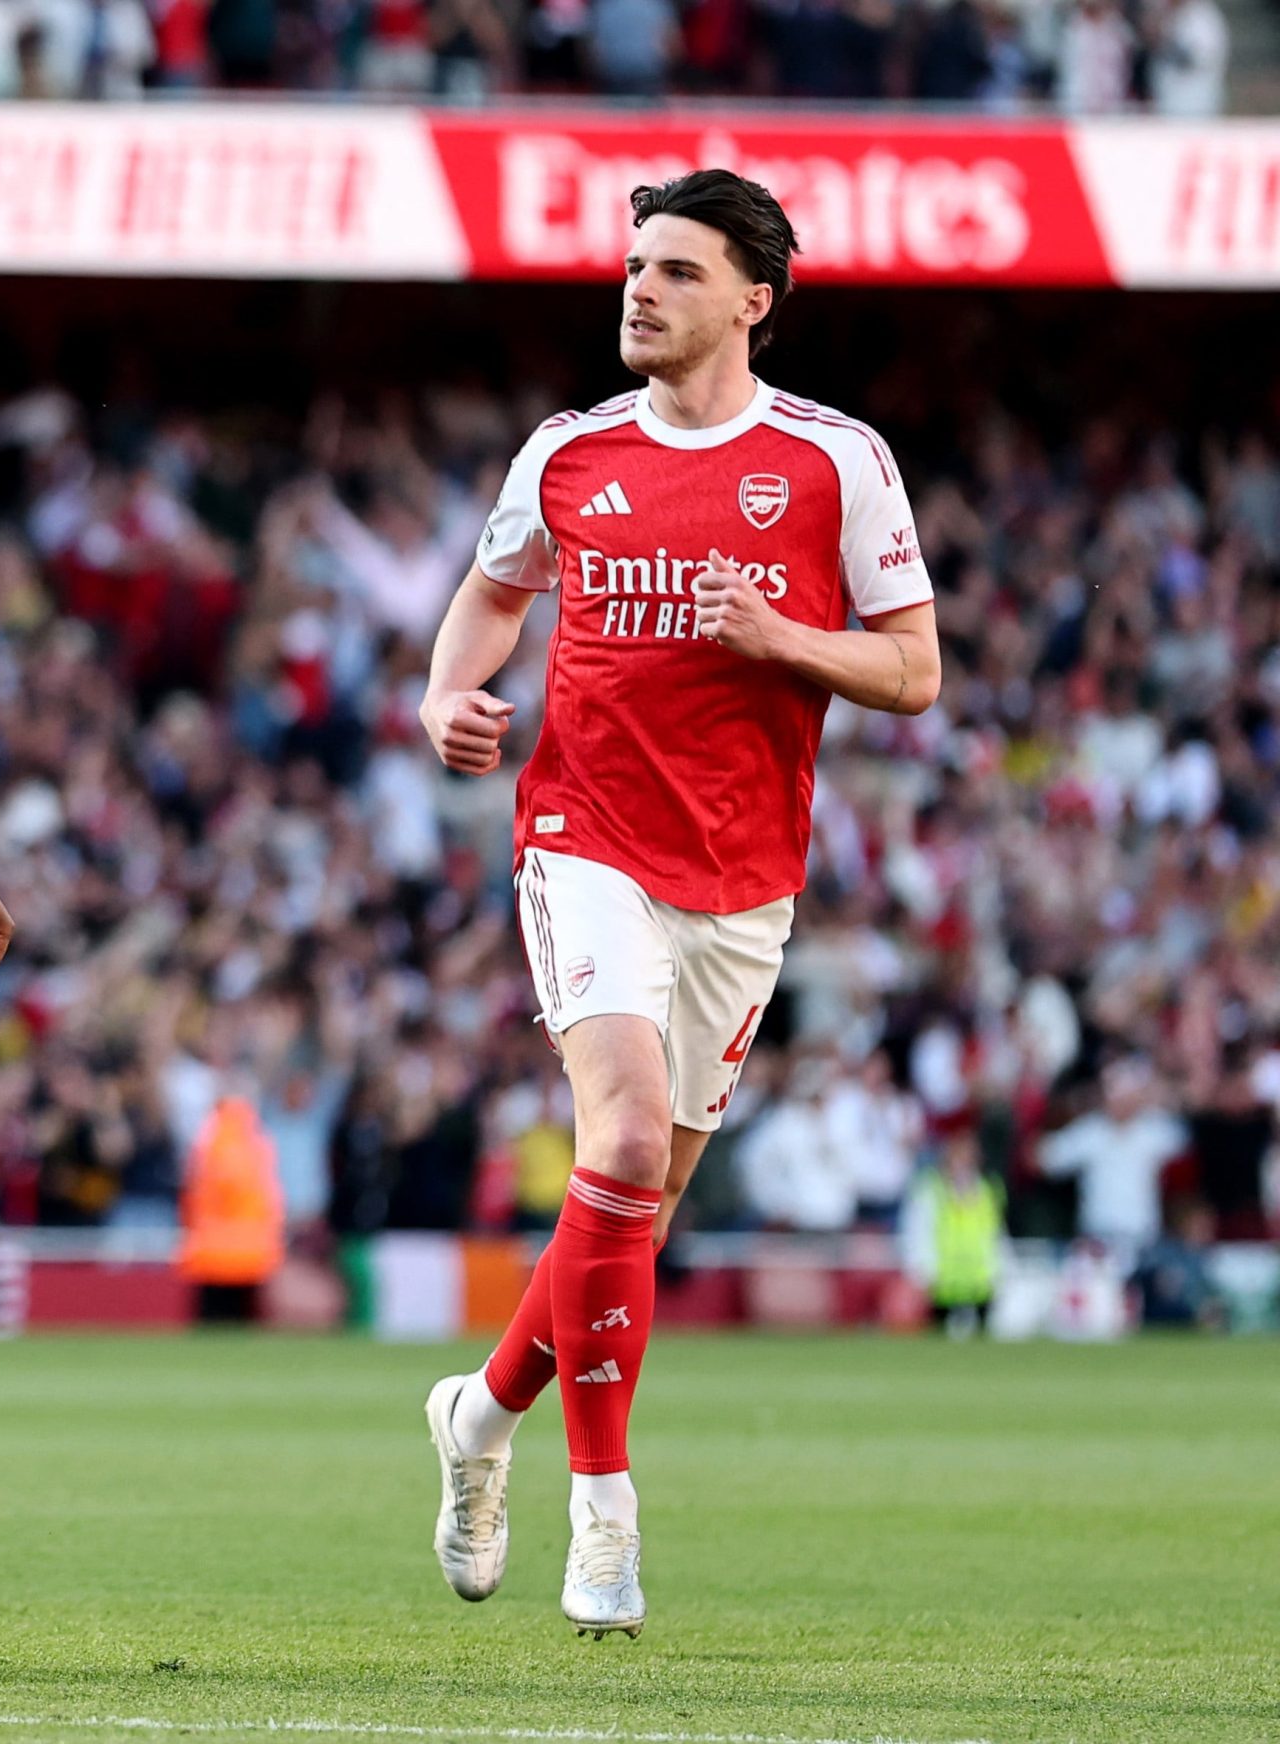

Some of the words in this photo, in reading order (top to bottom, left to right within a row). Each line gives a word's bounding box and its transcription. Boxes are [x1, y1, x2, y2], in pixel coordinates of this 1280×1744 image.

[747, 482, 782, 493] Arsenal
[602, 600, 648, 637] FLY
[722, 1005, 753, 1074] 4
